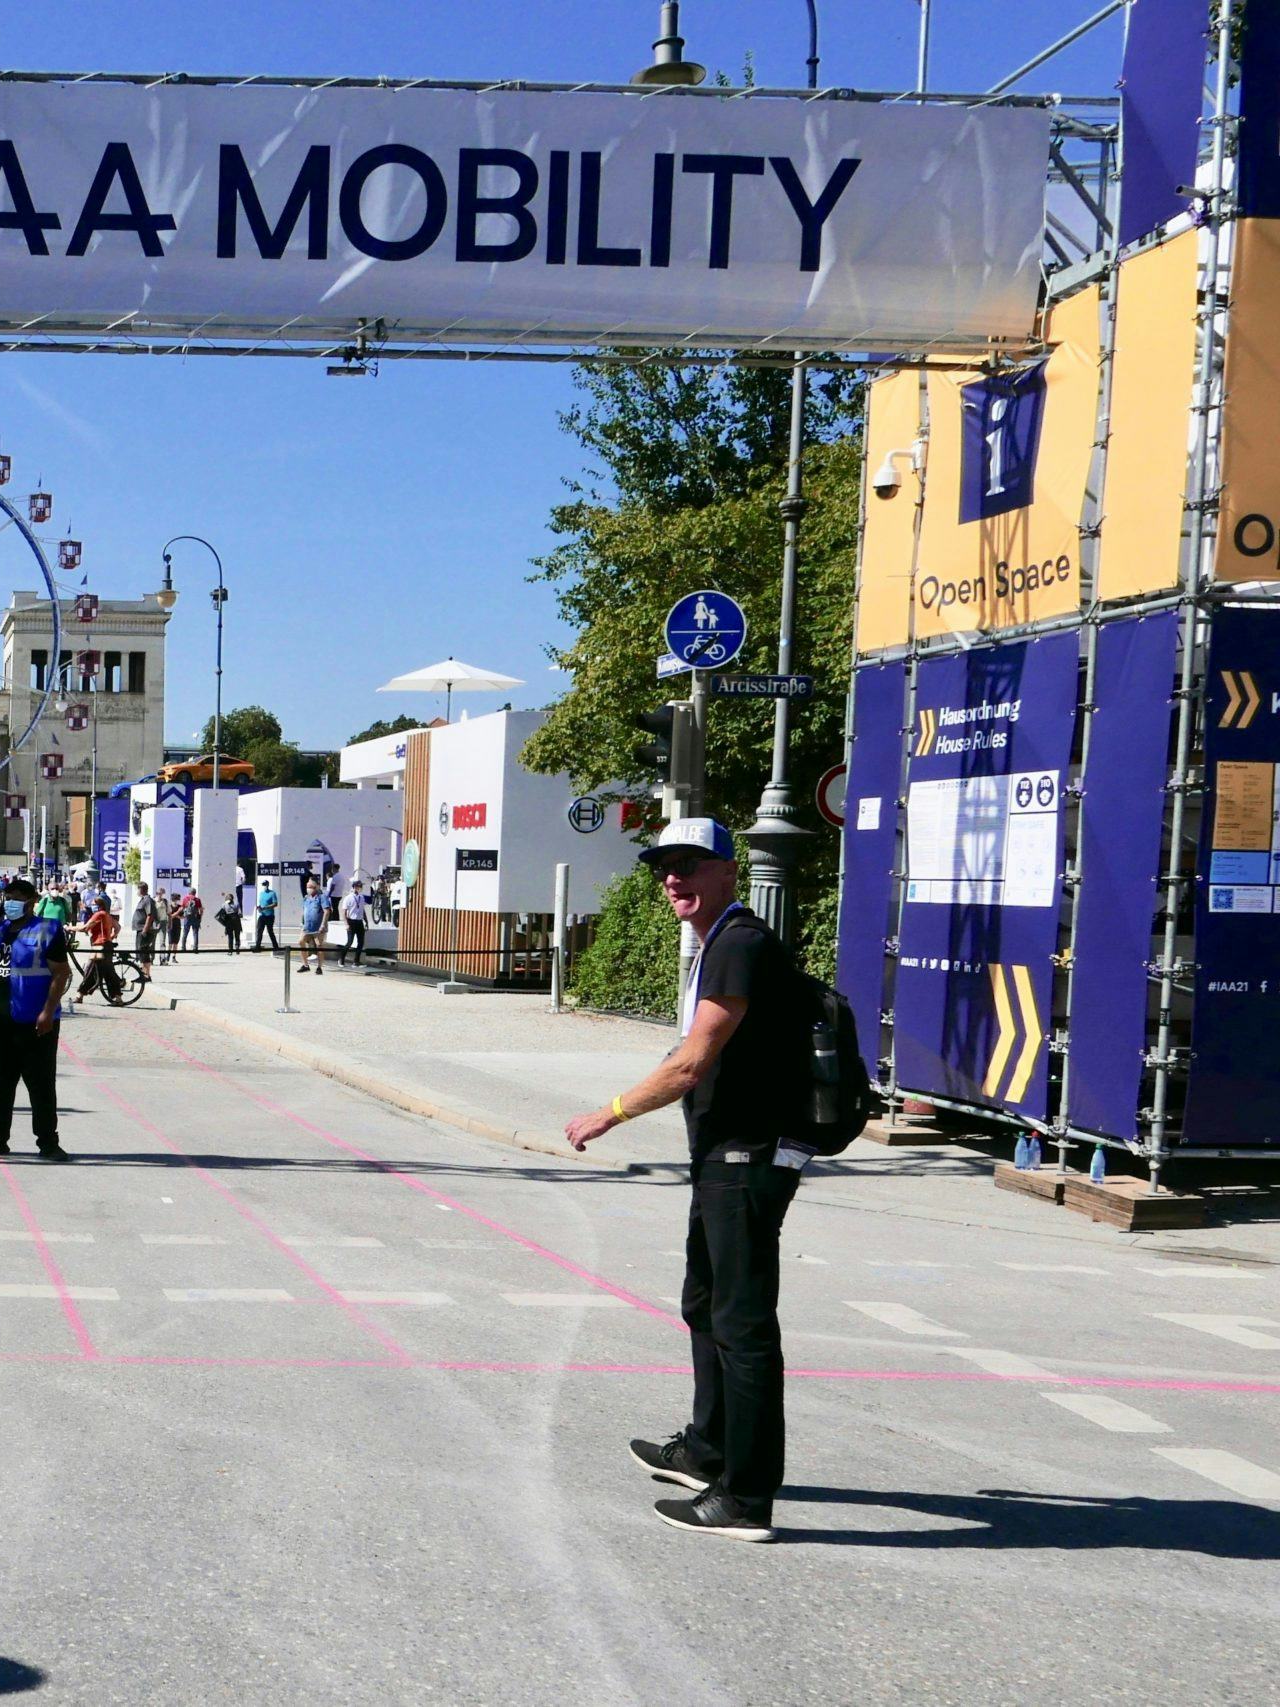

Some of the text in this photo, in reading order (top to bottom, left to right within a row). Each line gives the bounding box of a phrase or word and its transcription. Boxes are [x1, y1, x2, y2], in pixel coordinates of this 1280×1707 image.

[217, 143, 861, 272] MOBILITY
[919, 553, 1071, 616] Open Space
[719, 677, 807, 696] Arcisstraße
[938, 698, 1021, 727] Hausordnung
[934, 728, 1007, 755] House Rules
[452, 803, 487, 830] BOSCH
[462, 859, 494, 869] KP.145
[1207, 980, 1249, 993] #IAA21
